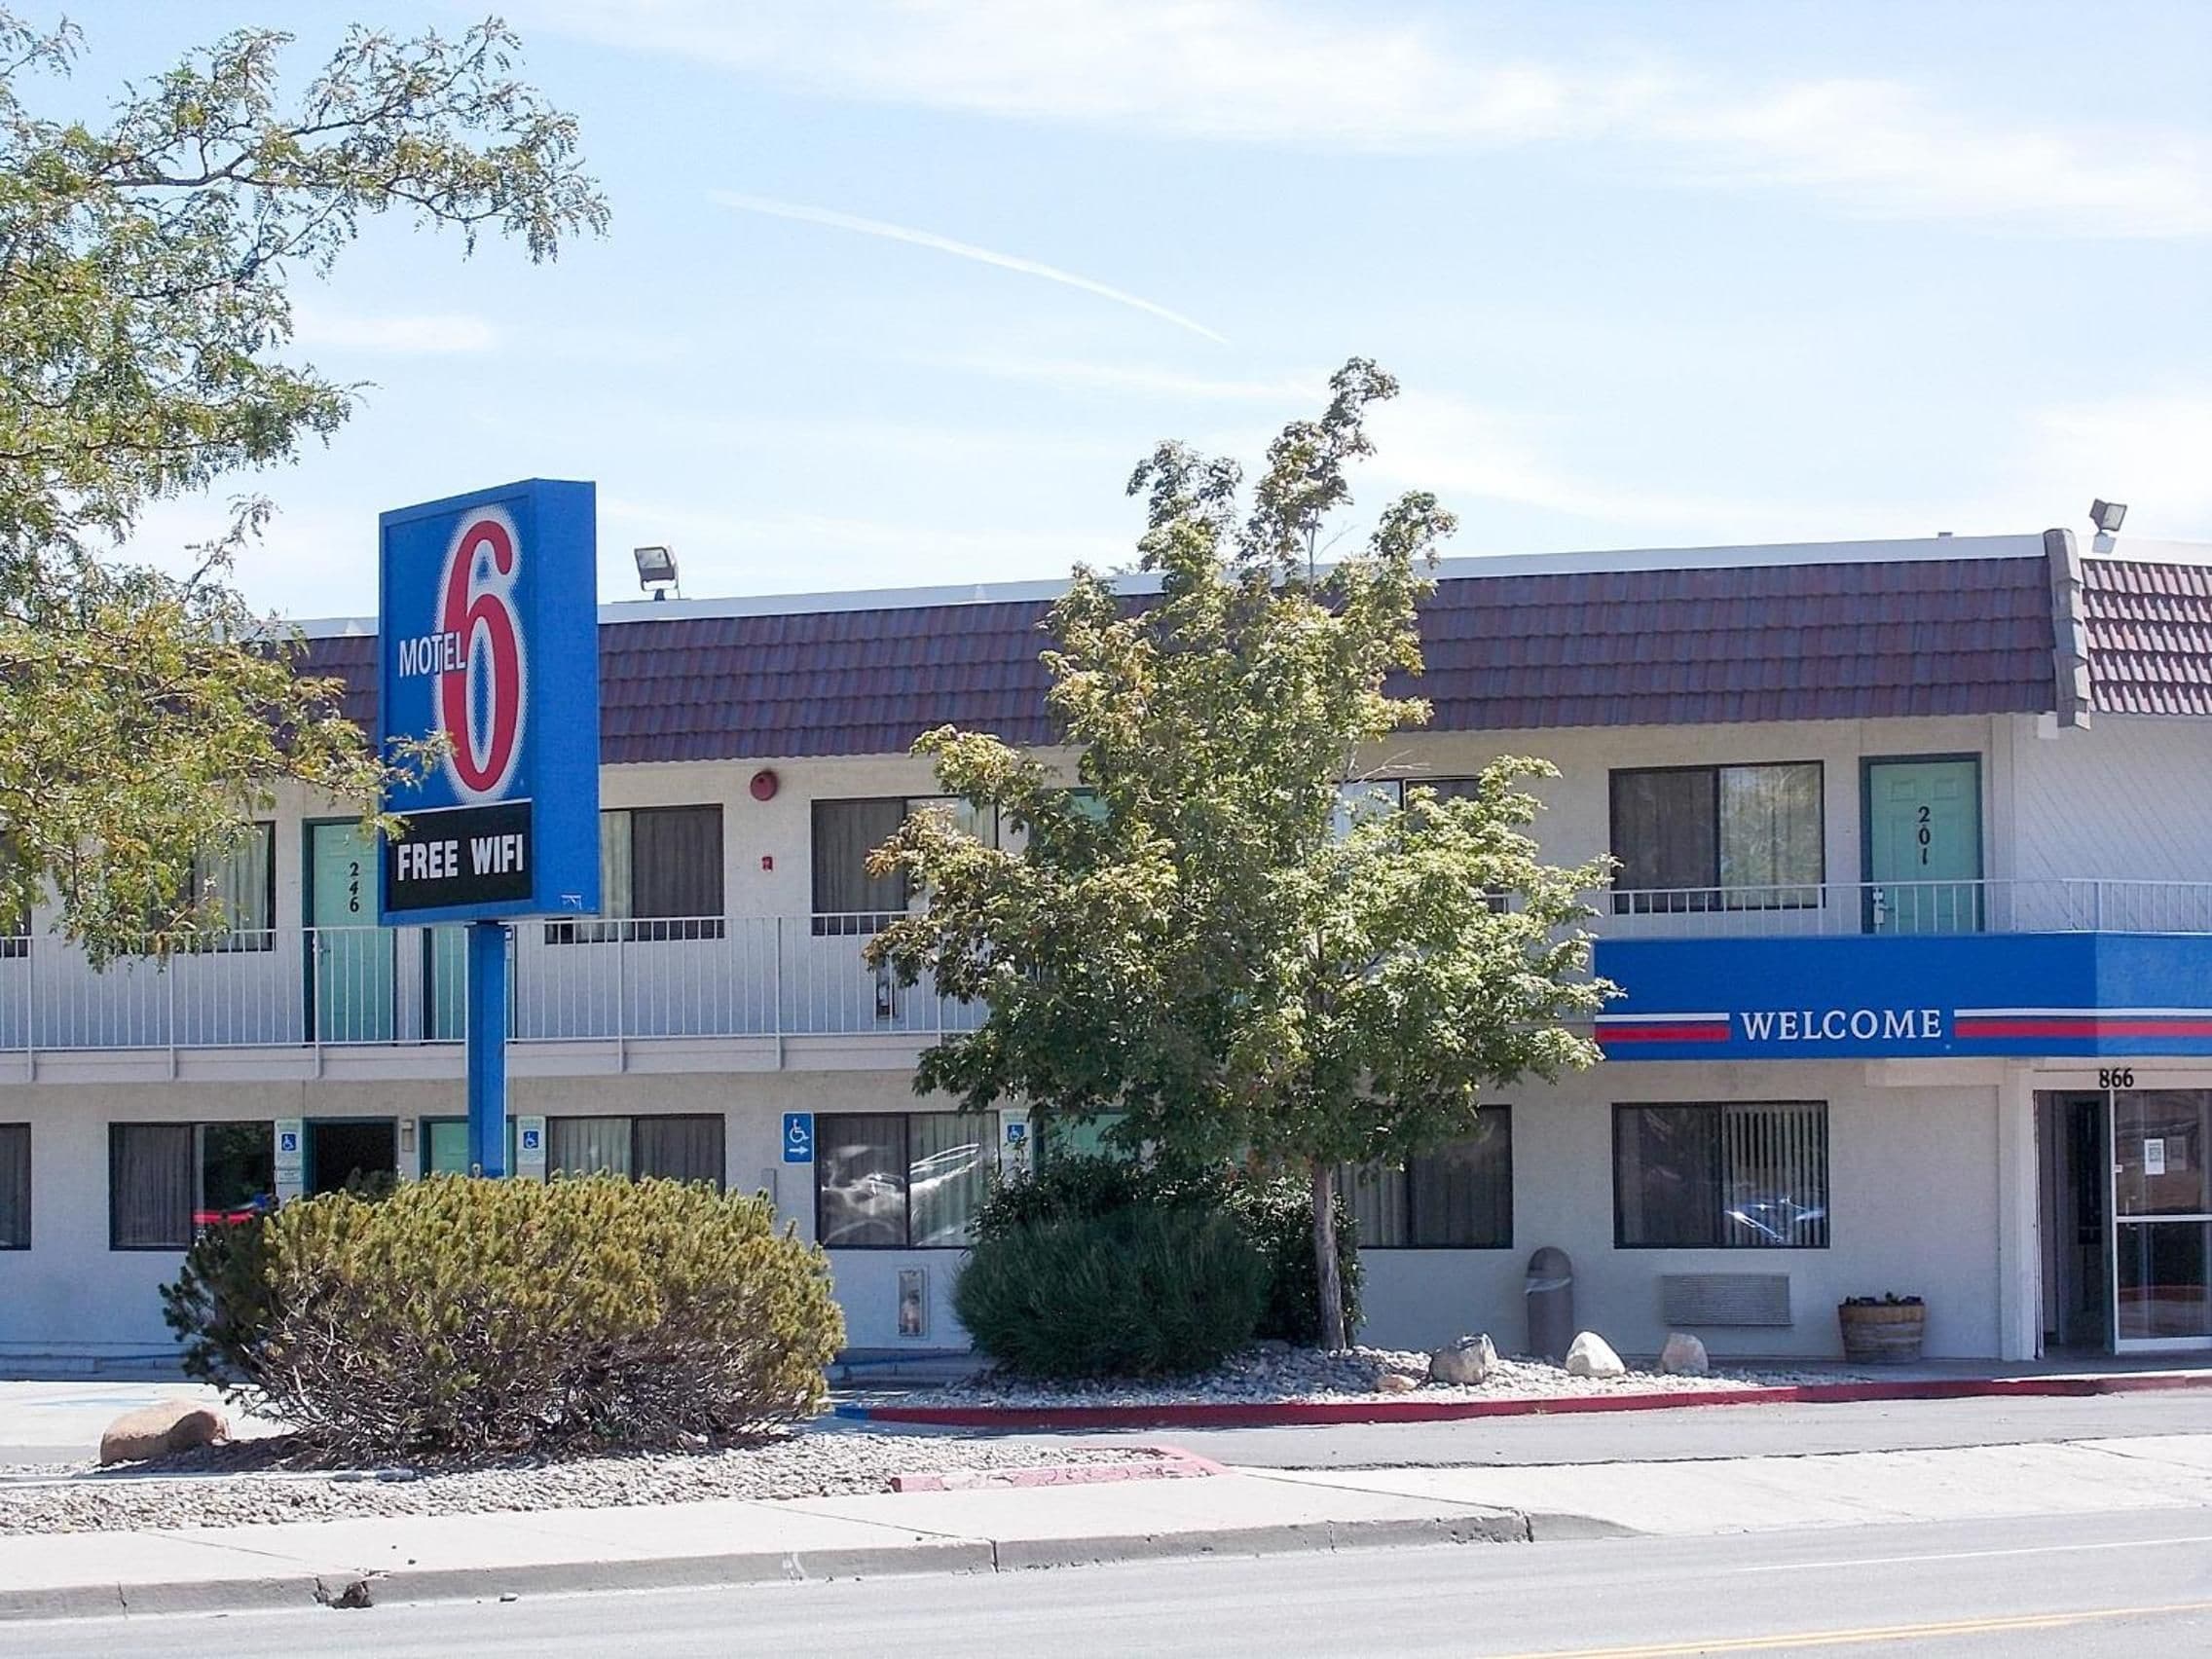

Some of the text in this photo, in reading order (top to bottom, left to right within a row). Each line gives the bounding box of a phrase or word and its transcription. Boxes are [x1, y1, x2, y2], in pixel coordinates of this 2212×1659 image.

[398, 520, 520, 793] MOTEL 6
[397, 833, 524, 882] FREE WIFI
[1918, 805, 1931, 865] 201
[349, 862, 359, 912] 246
[1740, 1010, 1942, 1040] WELCOME
[2099, 1068, 2134, 1088] 866
